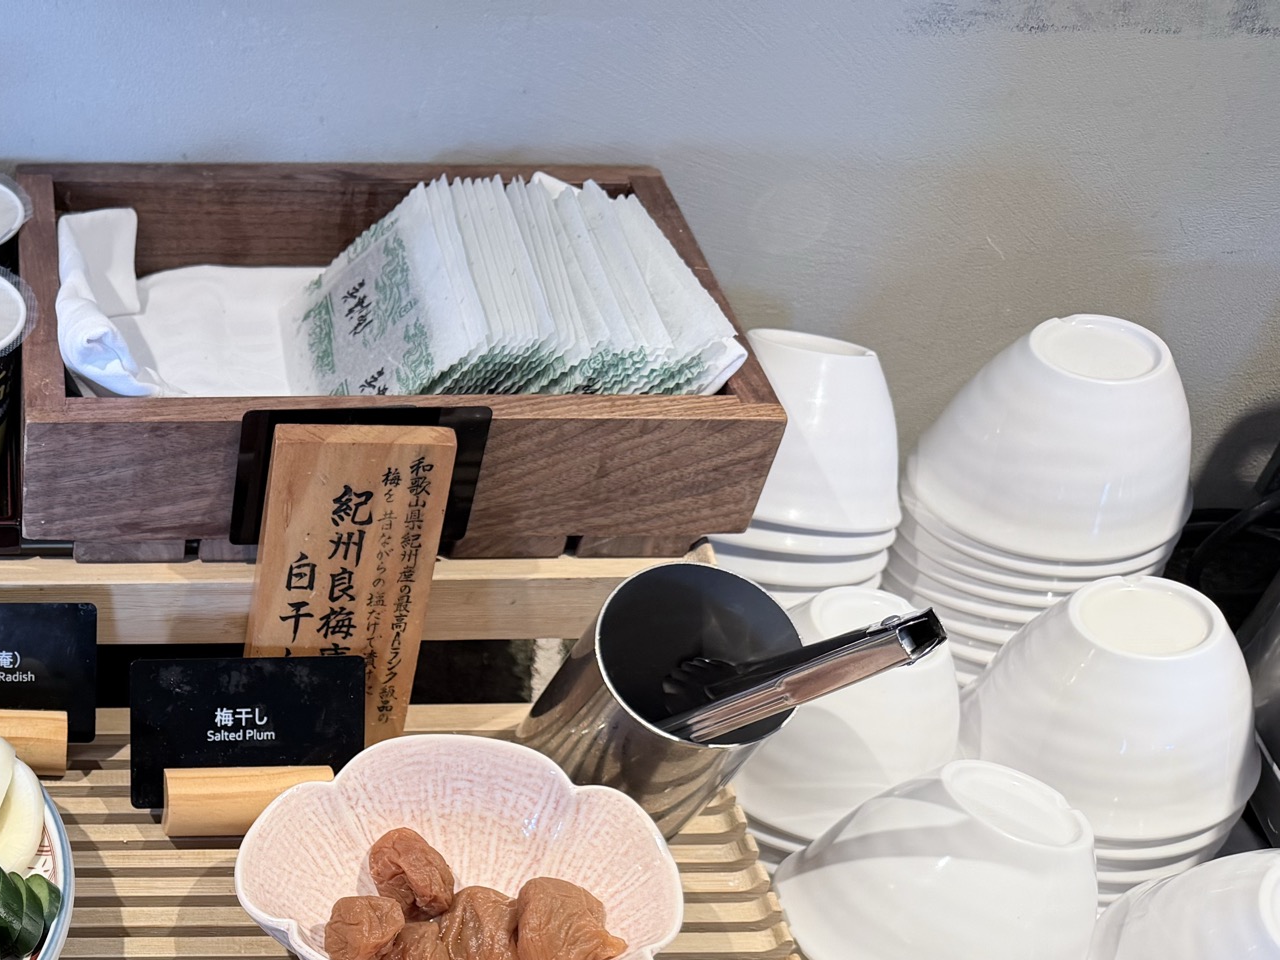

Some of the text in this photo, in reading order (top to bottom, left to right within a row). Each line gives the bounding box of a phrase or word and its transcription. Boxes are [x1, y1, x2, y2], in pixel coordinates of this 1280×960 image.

[280, 552, 317, 657] 白干
[215, 707, 268, 727] 梅干し
[207, 729, 276, 742] Salted Plum
